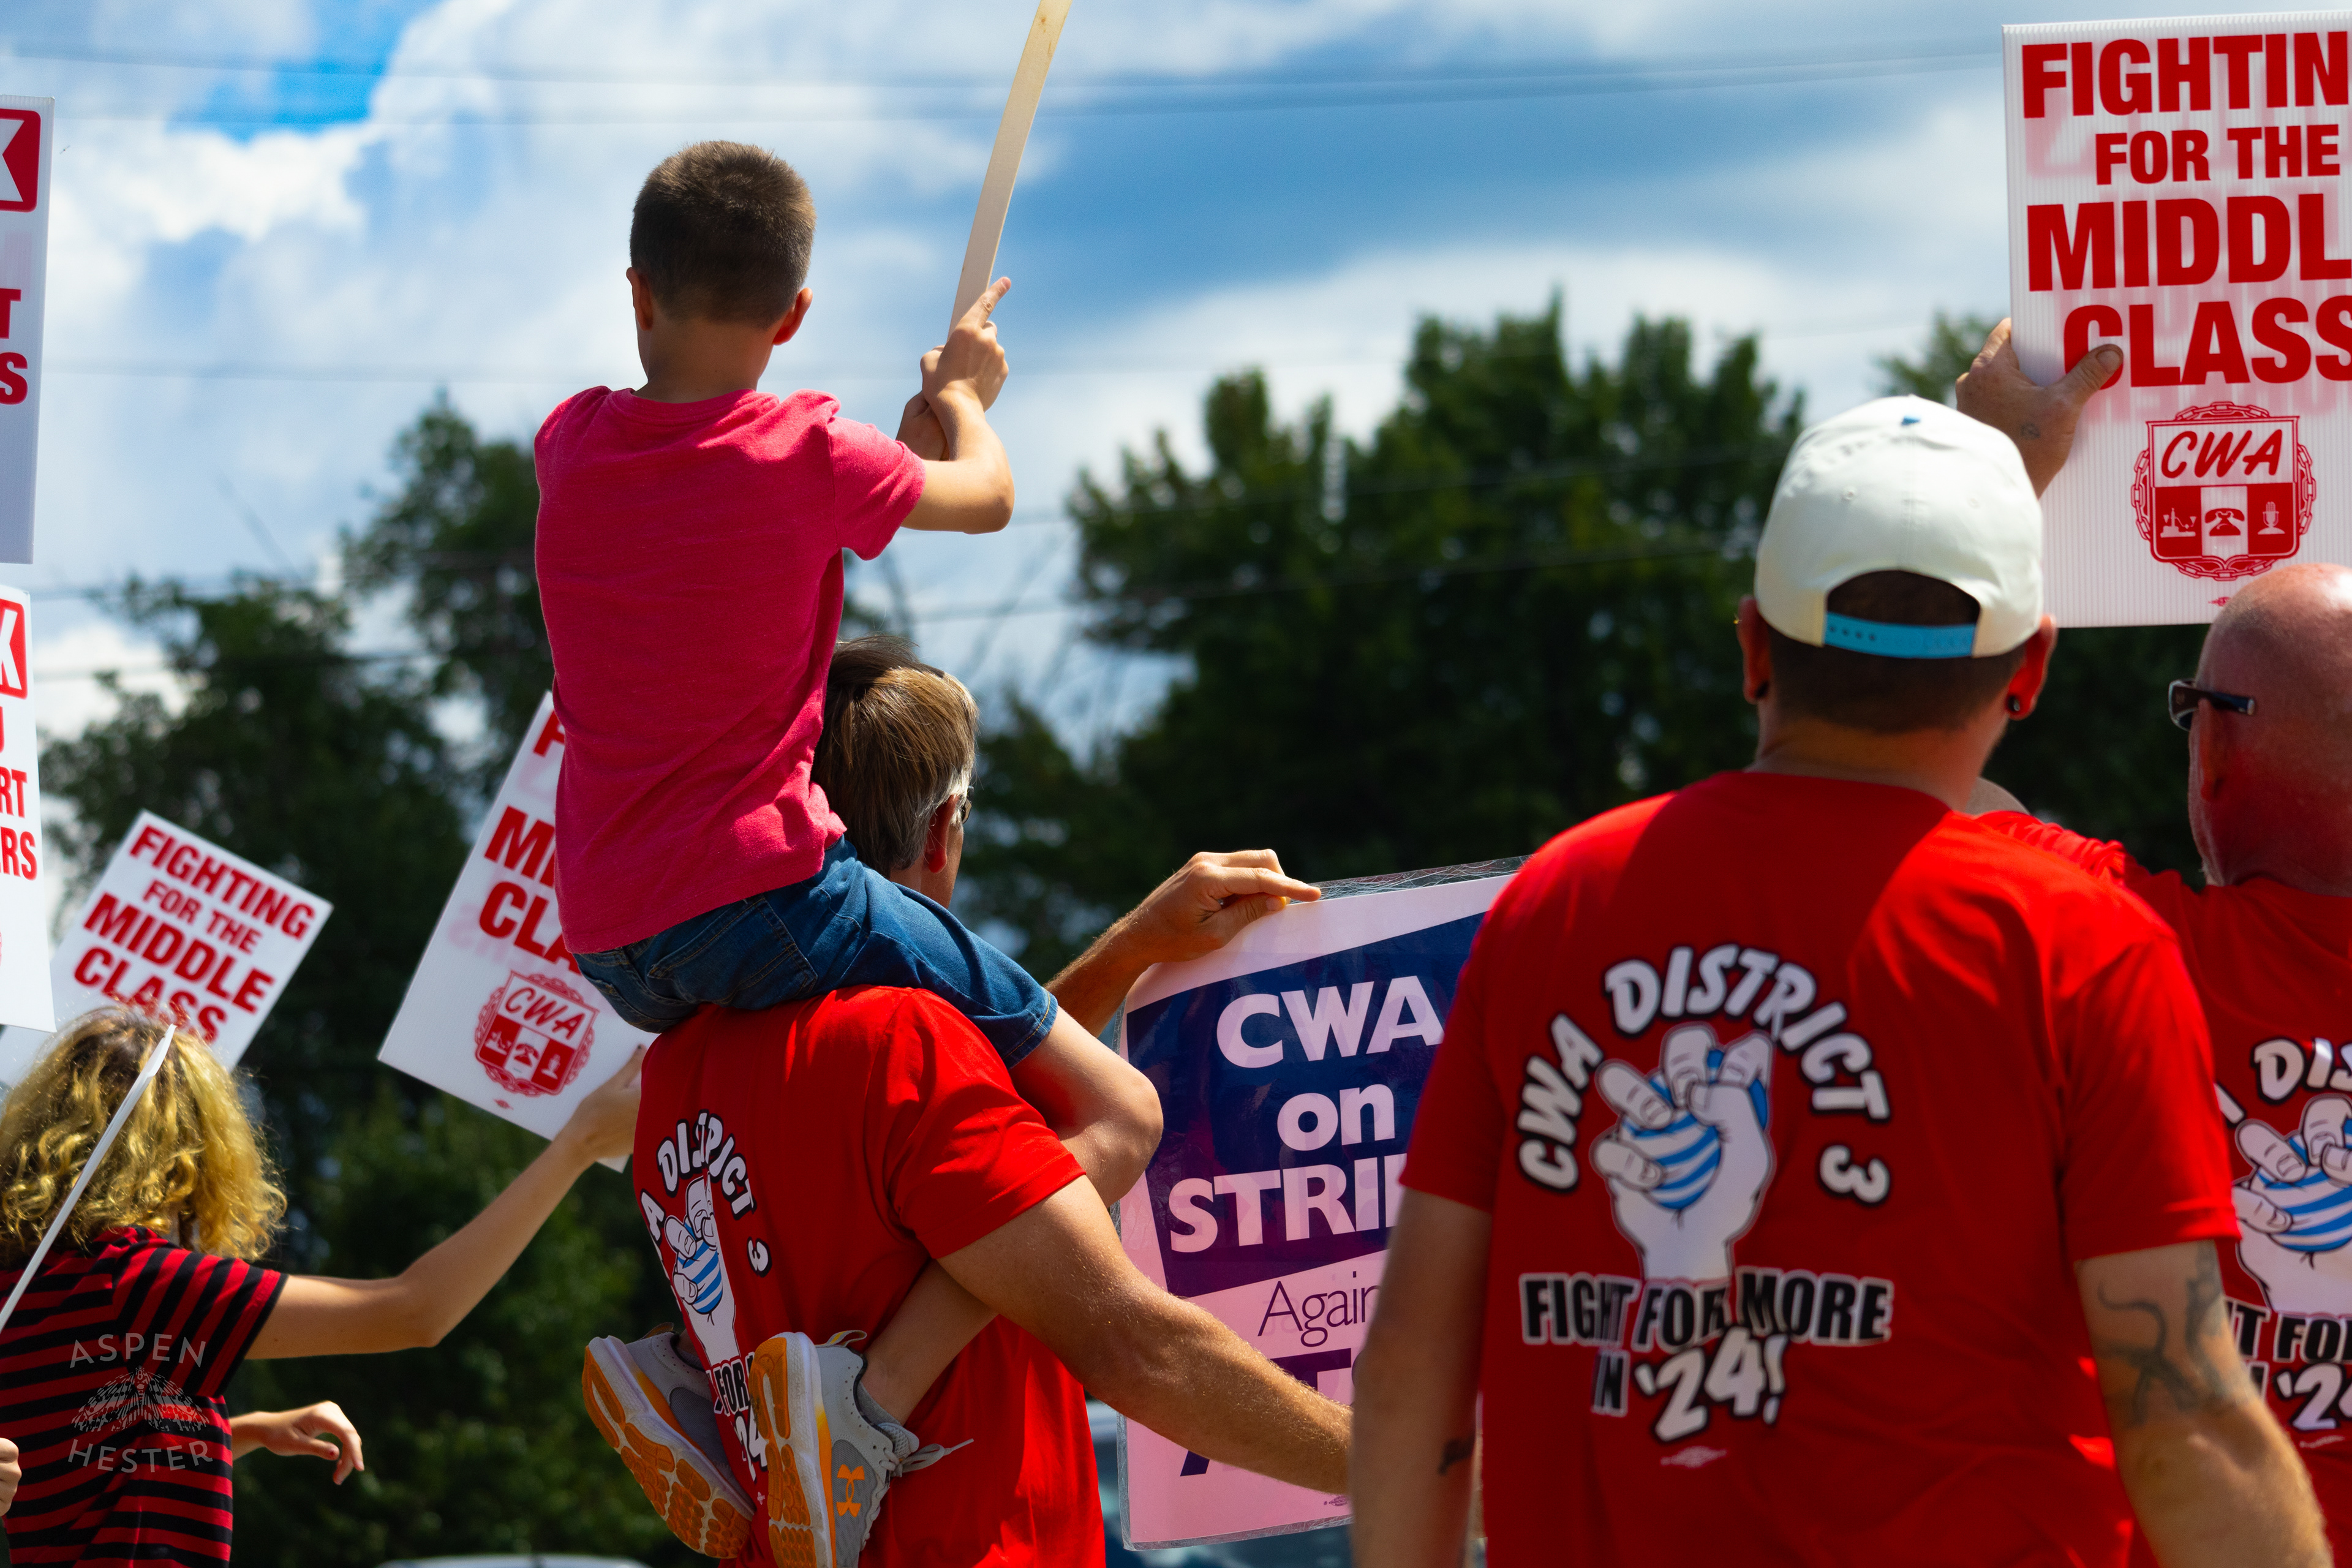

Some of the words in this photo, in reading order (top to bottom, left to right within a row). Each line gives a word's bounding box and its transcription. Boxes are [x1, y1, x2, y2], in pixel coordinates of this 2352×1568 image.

[2022, 31, 2350, 119] FIGHTIN
[2095, 129, 2212, 185] FOR
[2227, 124, 2341, 179] THE
[2027, 193, 2352, 292] MIDDL
[2064, 295, 2352, 391] CLASS
[2161, 429, 2283, 478] CWA
[129, 824, 315, 941] FIGHTING
[143, 880, 202, 924] FOR
[205, 909, 263, 955] THE
[83, 892, 276, 1014] MIDDLE
[504, 986, 587, 1042] CWA
[1216, 975, 1446, 1068] CWA
[1277, 1084, 1395, 1151] on
[1518, 1014, 1604, 1189] CWA
[1604, 944, 1891, 1120] DISTRICT
[1819, 1145, 1891, 1204] 3
[1168, 1153, 1407, 1253] STRI
[747, 1238, 771, 1275] 3
[1257, 1271, 1380, 1347] Again
[1520, 1272, 1641, 1346] FIGHT
[1632, 1280, 1732, 1353] FOR
[1735, 1266, 1894, 1346] MORE
[2273, 1312, 2352, 1364] FO
[713, 1359, 750, 1417] FOR
[1634, 1326, 1788, 1442] '24!
